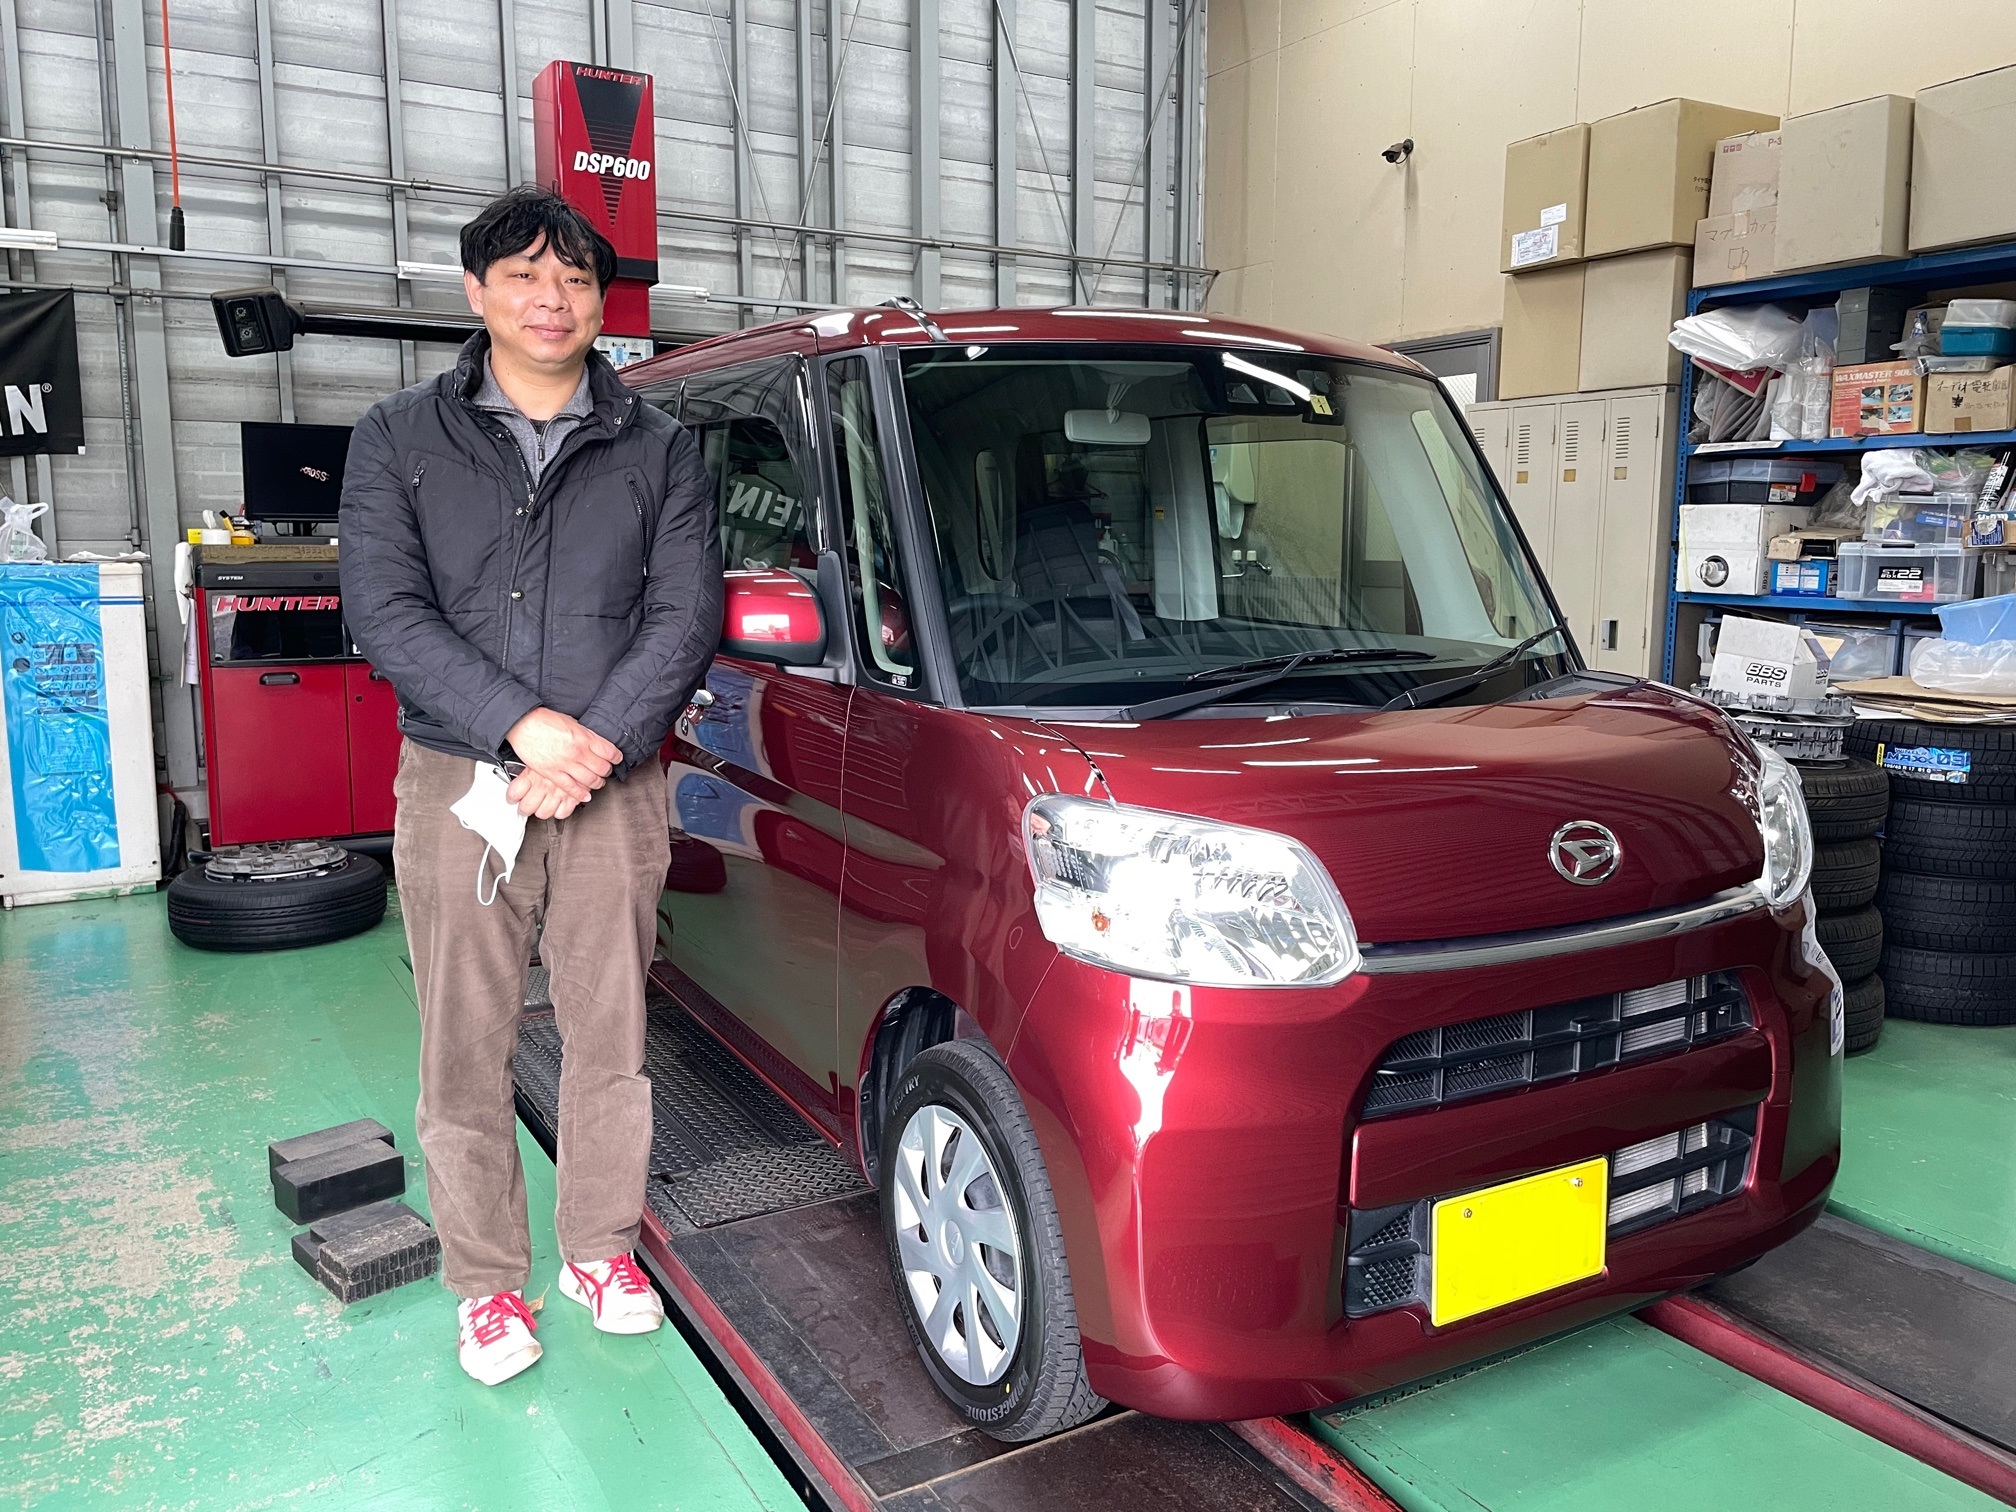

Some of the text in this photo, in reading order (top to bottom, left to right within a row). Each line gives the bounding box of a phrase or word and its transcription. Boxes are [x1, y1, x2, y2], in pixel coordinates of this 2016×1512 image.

[576, 66, 643, 86] HUNTER
[573, 150, 651, 181] DSP600
[1835, 369, 1893, 382] WAXMASTER
[1896, 569, 1922, 579] 22
[215, 595, 340, 612] HUNTER
[1746, 662, 1787, 681] BBS
[1746, 676, 1782, 688] PARTS
[1885, 752, 1967, 767] MAXX 03
